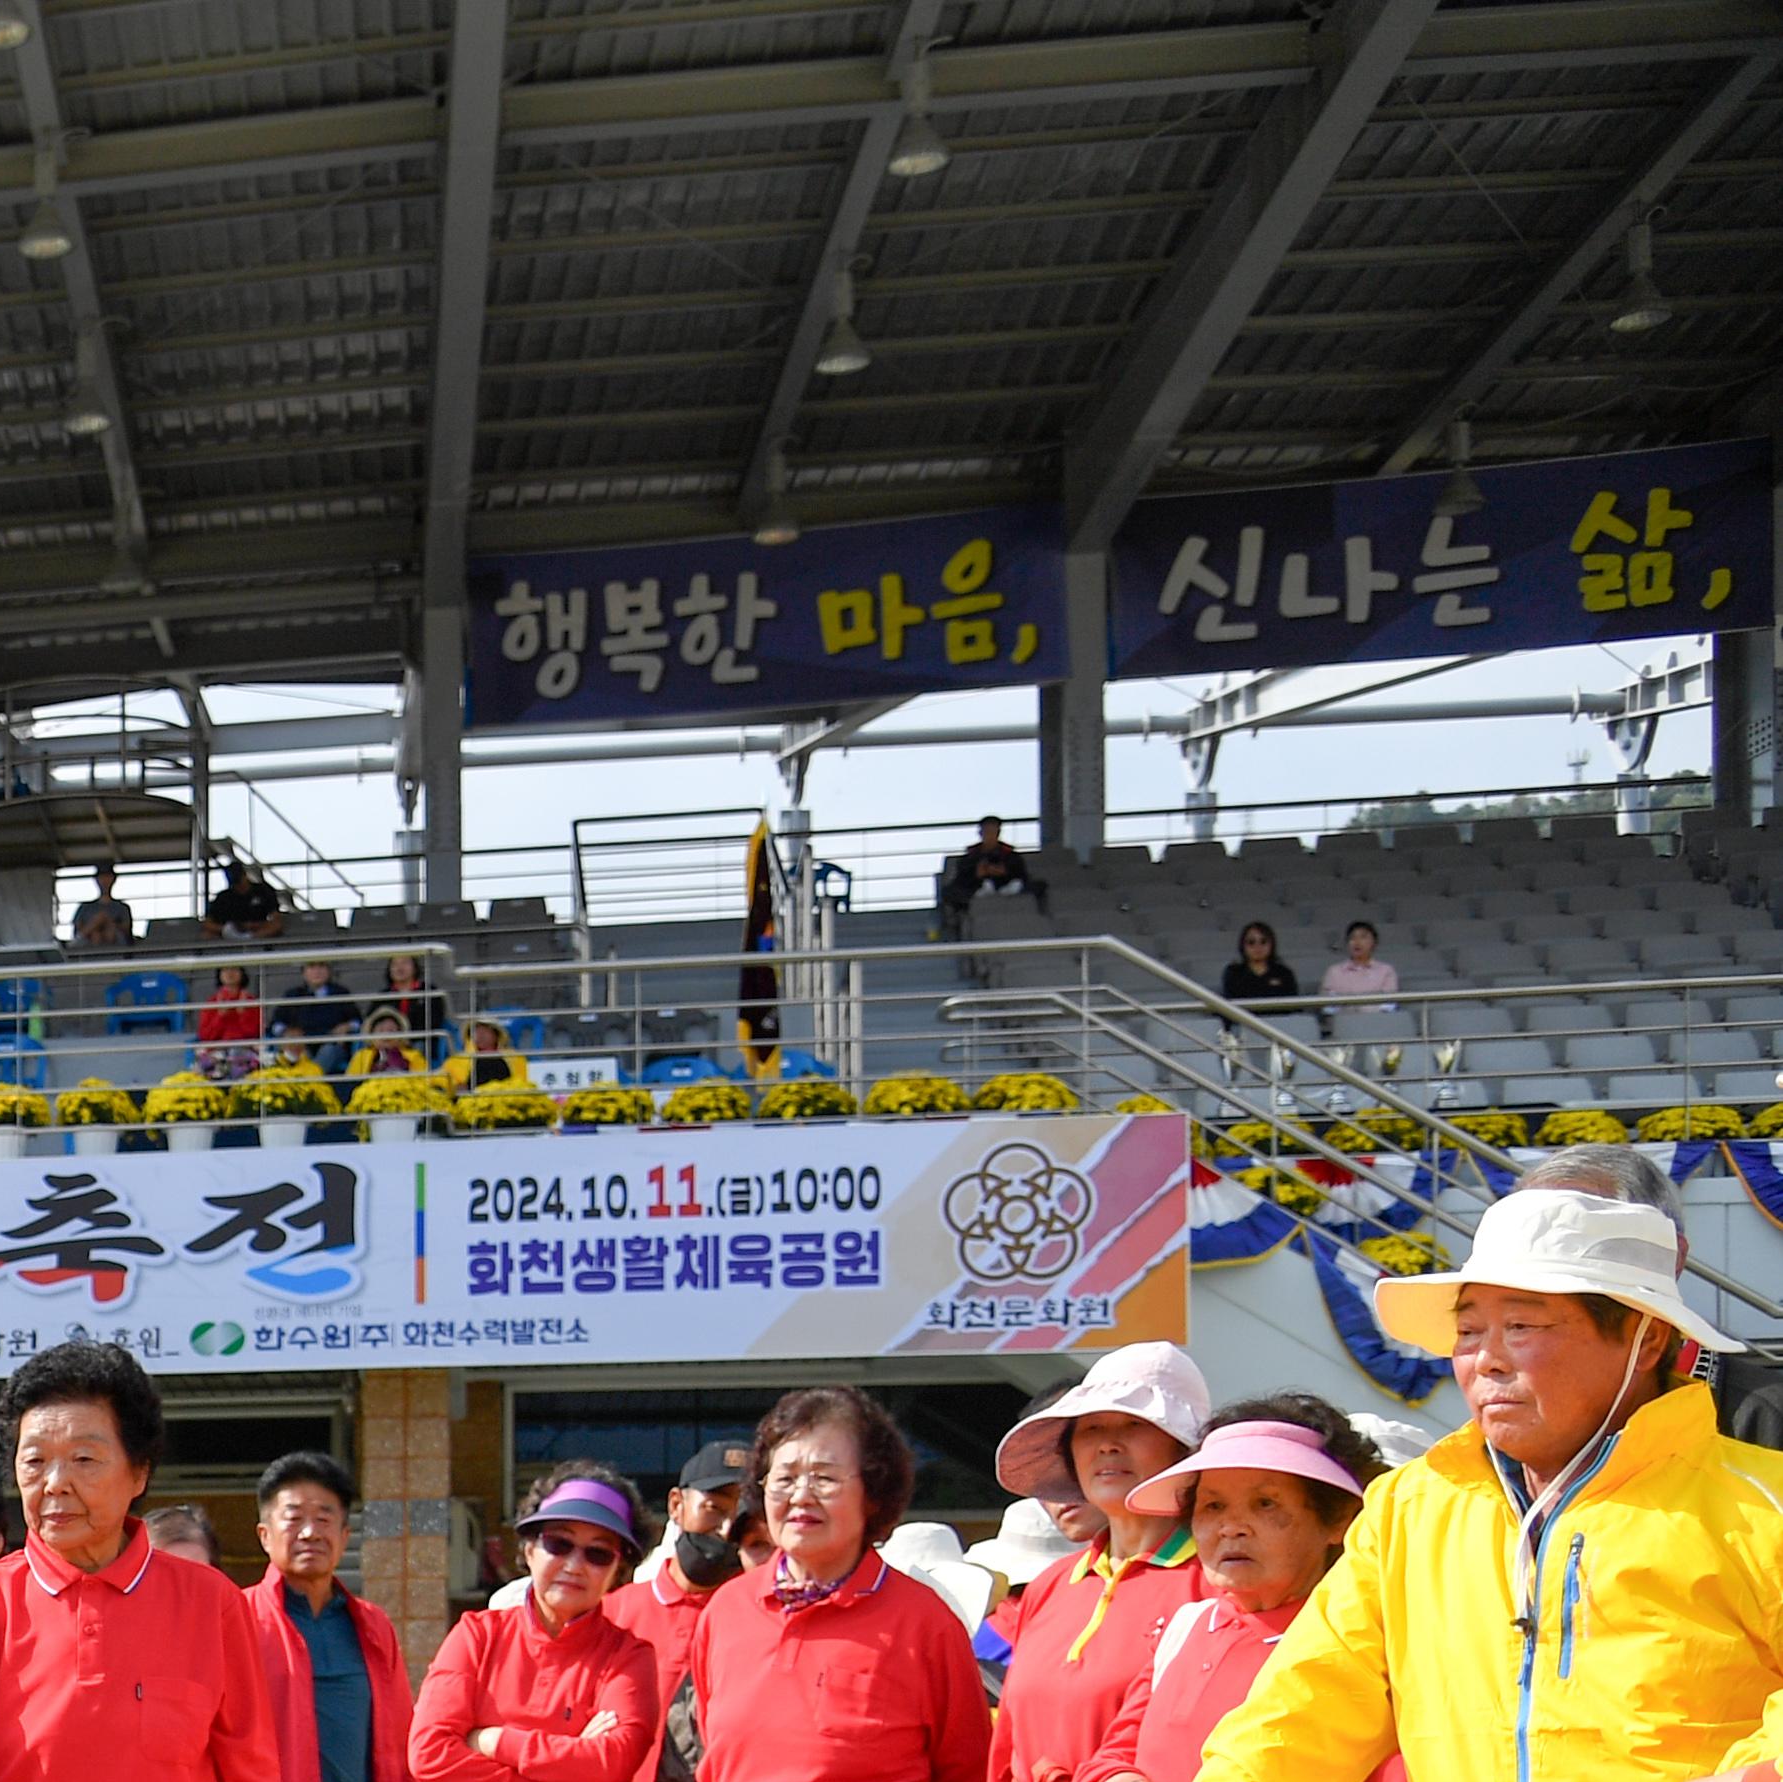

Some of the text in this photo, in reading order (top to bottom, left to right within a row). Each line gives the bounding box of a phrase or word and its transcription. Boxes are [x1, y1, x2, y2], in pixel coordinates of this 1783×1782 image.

[1157, 486, 1733, 643] 신나는 삶,
[494, 537, 1038, 699] 행복한 마음,
[466, 1229, 882, 1298] 화천생활체육공원
[402, 1318, 590, 1349] 화천수력발전소
[925, 1296, 1116, 1331] 화천문화원
